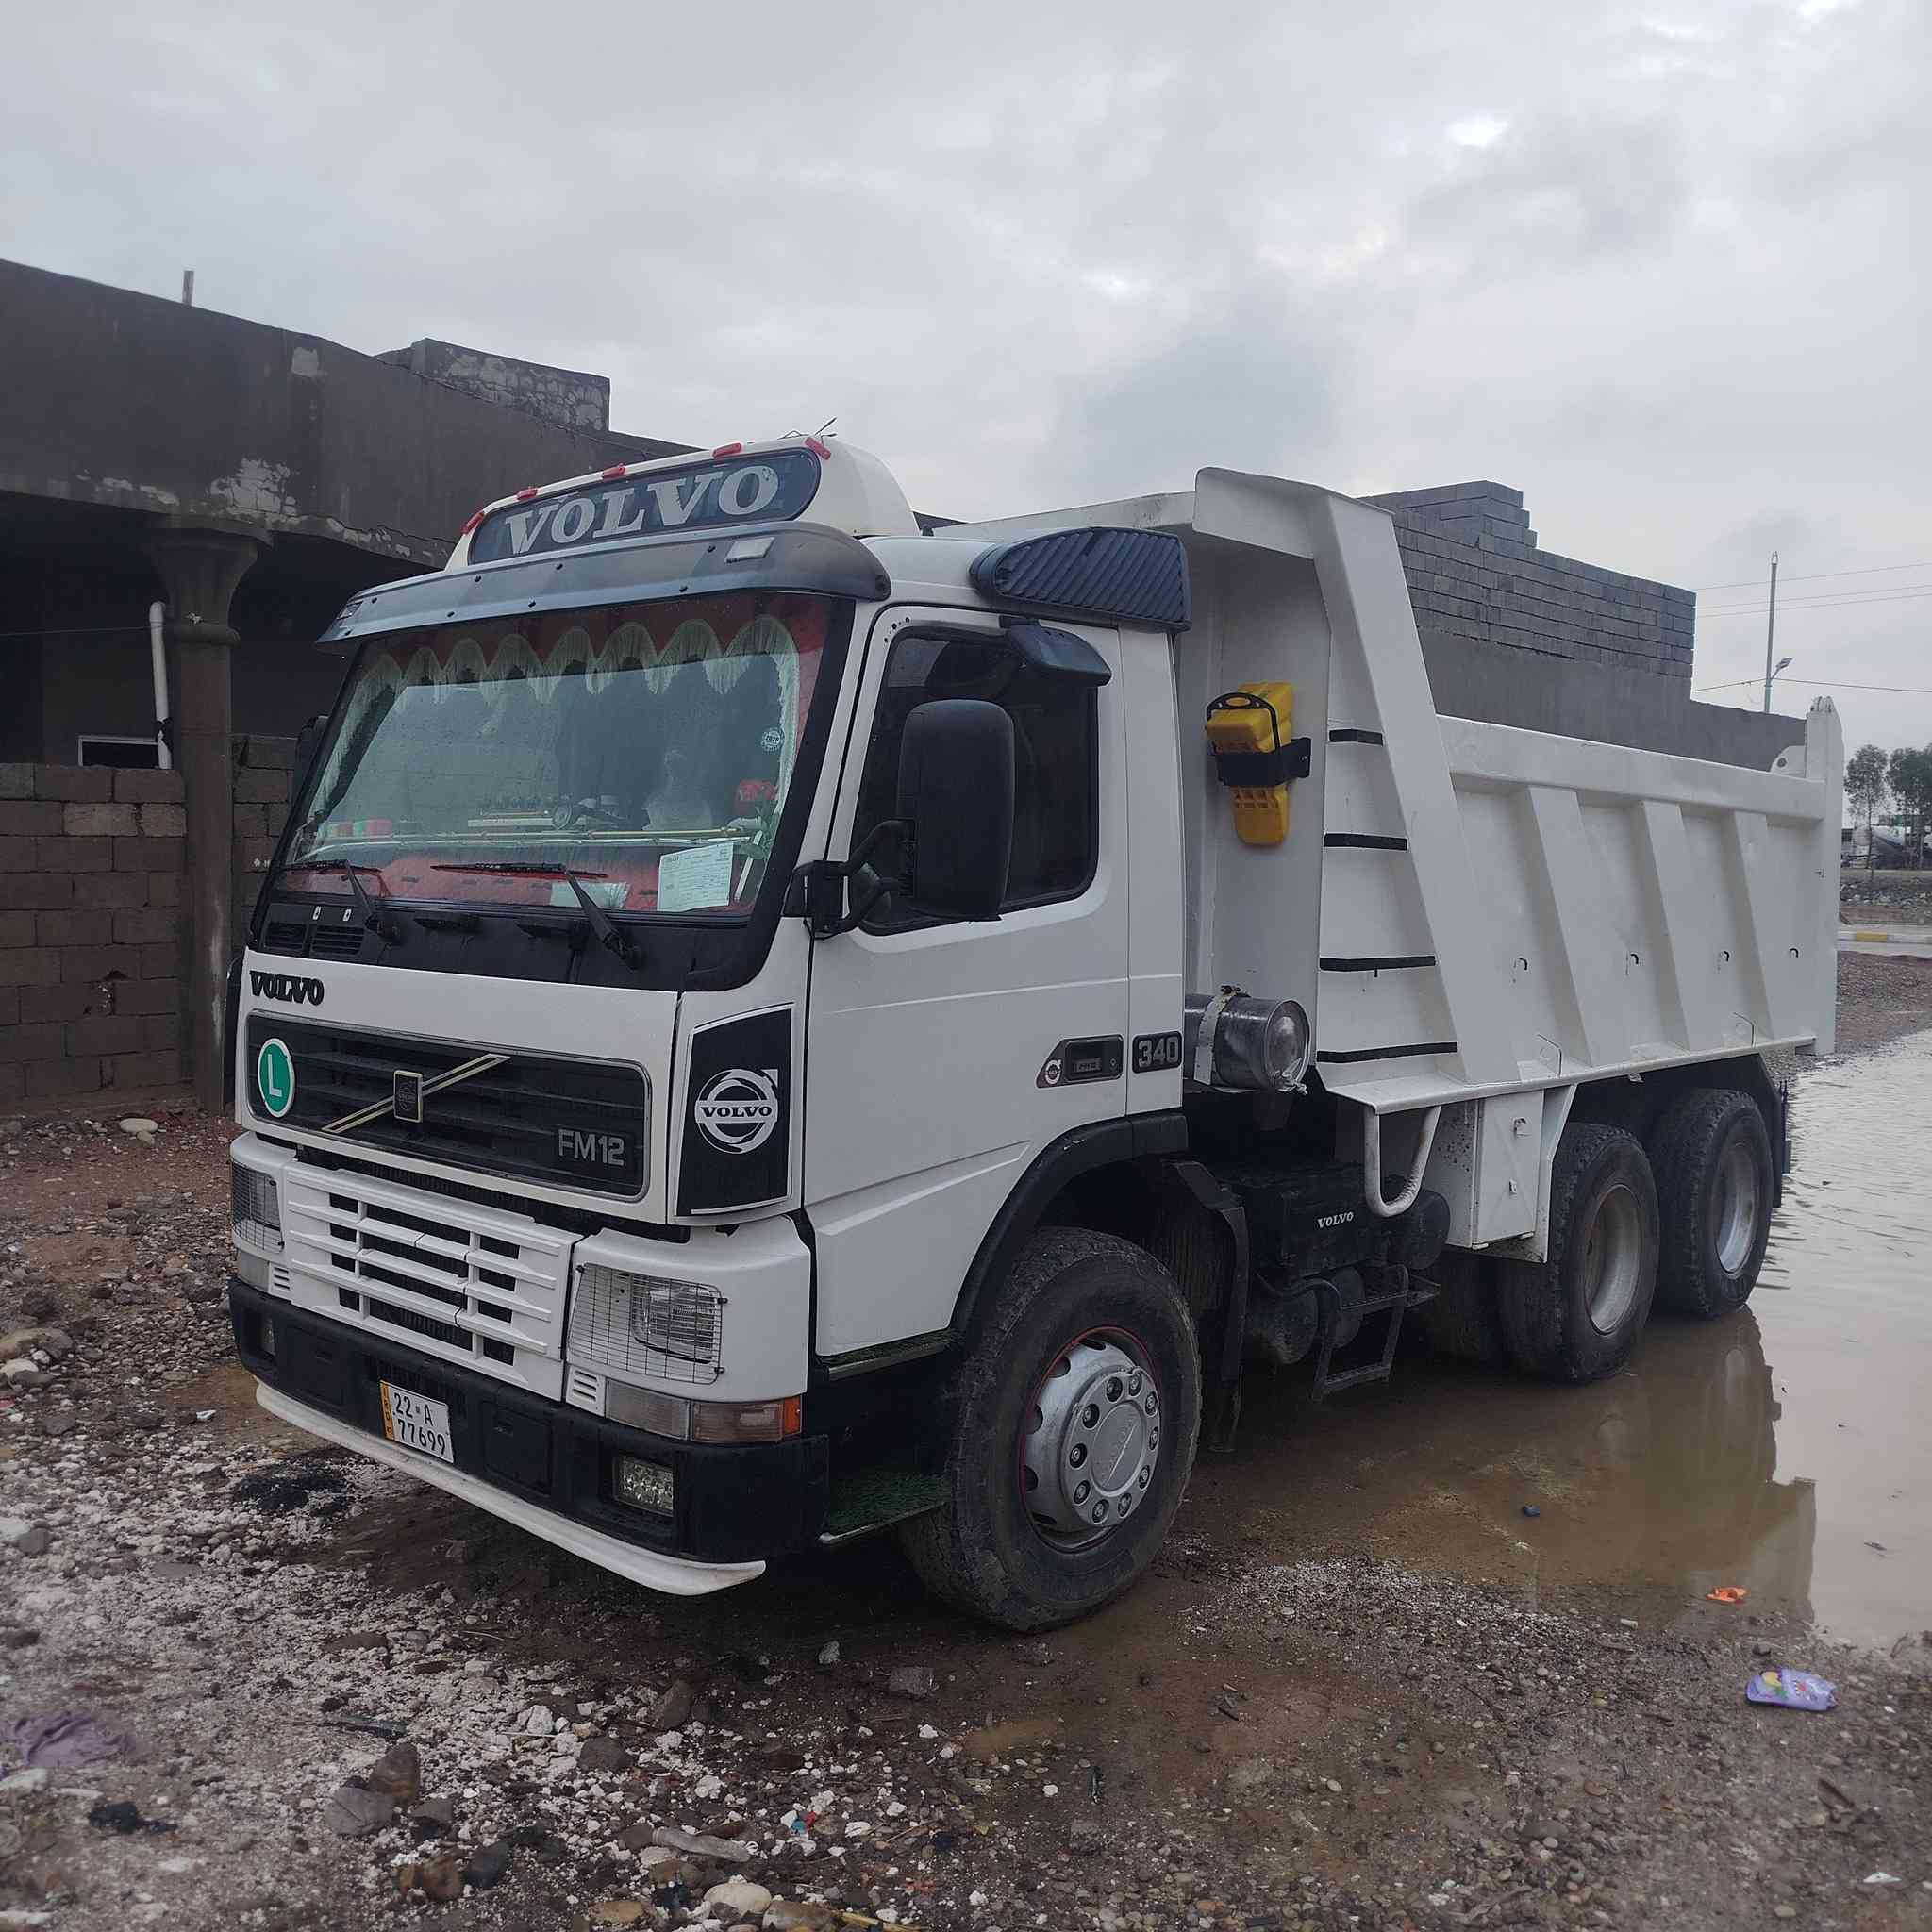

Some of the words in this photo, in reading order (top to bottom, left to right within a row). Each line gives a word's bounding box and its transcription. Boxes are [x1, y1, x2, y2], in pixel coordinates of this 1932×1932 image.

[506, 466, 779, 555] VOLVO
[249, 970, 325, 1006] VOLVO
[1138, 1037, 1179, 1068] 340
[267, 1053, 283, 1098] L
[701, 1106, 772, 1118] VOLVO
[558, 1128, 625, 1166] FM12
[1317, 1211, 1354, 1228] VOLVO
[394, 1392, 413, 1419] 22
[424, 1403, 434, 1427] A
[397, 1418, 445, 1456] 77699
